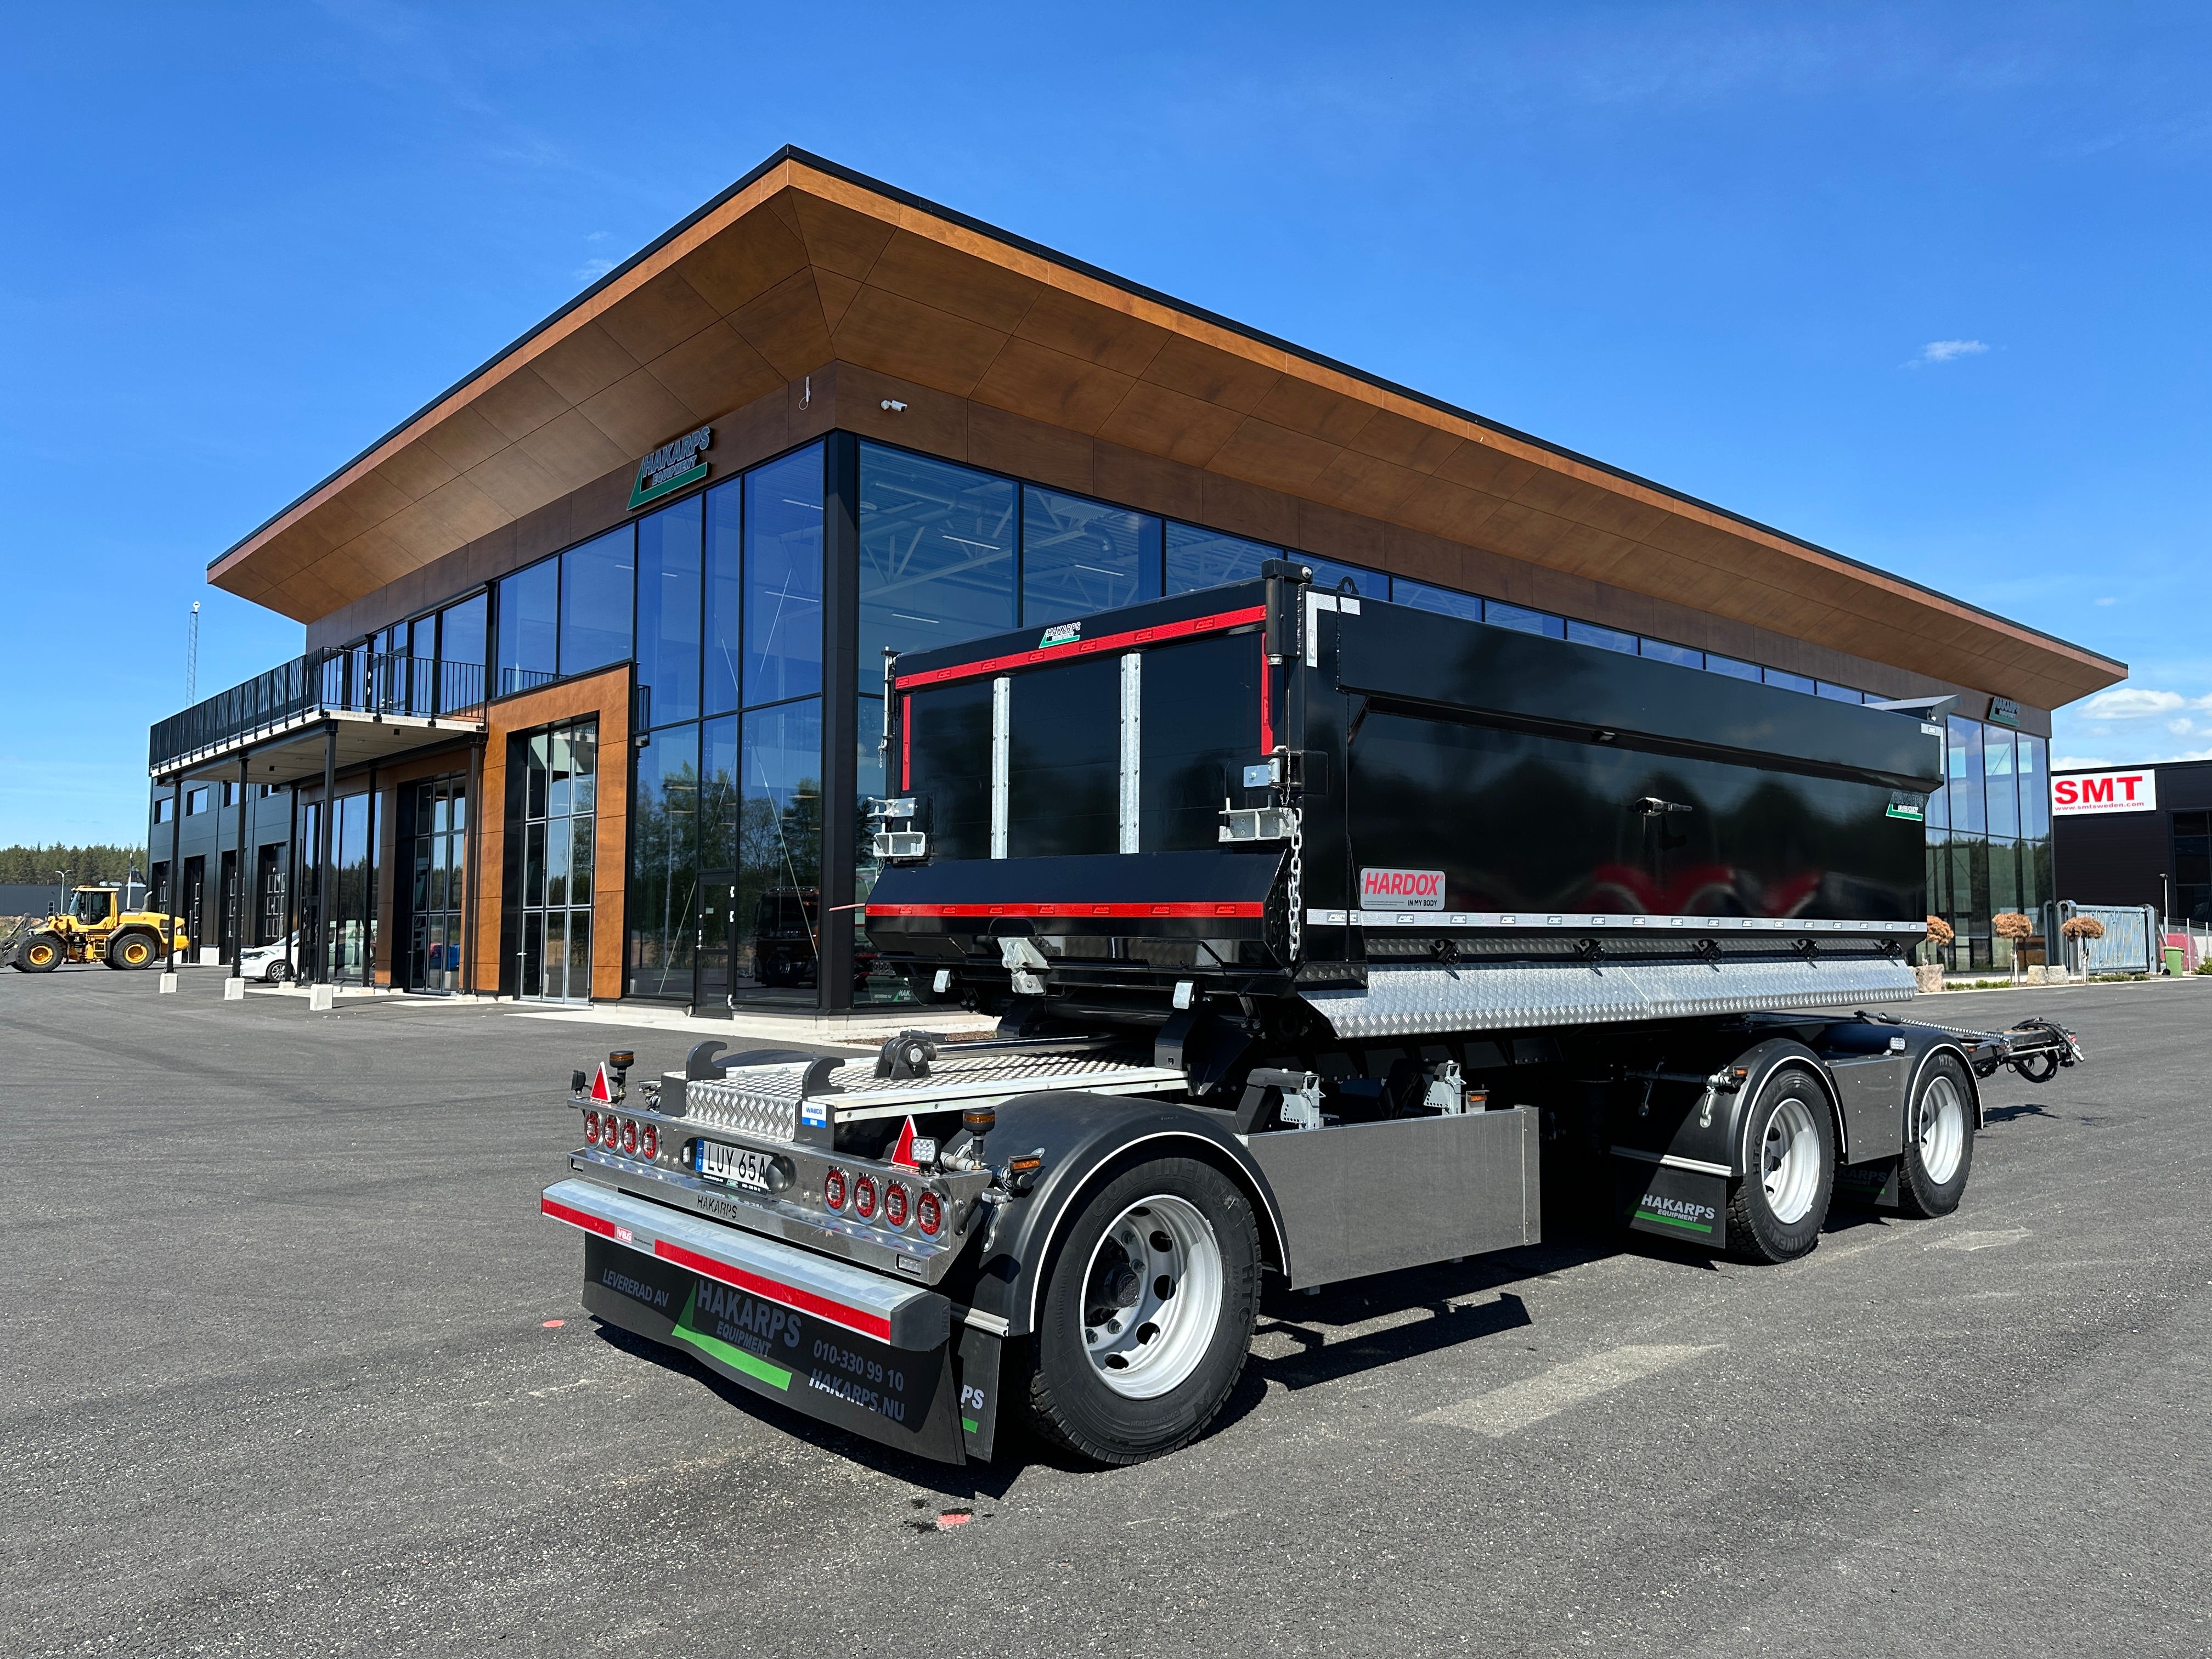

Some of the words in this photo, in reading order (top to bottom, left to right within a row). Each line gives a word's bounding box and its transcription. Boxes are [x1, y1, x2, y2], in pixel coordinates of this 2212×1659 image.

[642, 426, 710, 478] HAKARPS
[652, 455, 697, 486] EQUIPMENT
[1047, 622, 1081, 637] HAKARPS
[2055, 776, 2143, 804] SMT
[2055, 802, 2144, 811] www.smtsweden.com
[1364, 872, 1440, 895] HARDOX
[708, 1145, 734, 1176] LUY
[738, 1153, 766, 1184] 65A
[697, 1195, 737, 1219] HAKARPS
[1641, 1194, 1716, 1219] HAKARPS
[1657, 1209, 1698, 1222] EQUIPMENT
[618, 1228, 631, 1242] VBG
[603, 1268, 652, 1302] LEVERERAD
[654, 1289, 670, 1307] AV
[1239, 1262, 1253, 1327] HTC
[697, 1279, 802, 1348] HAKARPS
[716, 1321, 772, 1358] EQUIPMENT
[813, 1339, 864, 1375] 010-330
[867, 1361, 883, 1383] 99
[887, 1369, 904, 1391] 10
[809, 1368, 905, 1421] HAKARPS.NU
